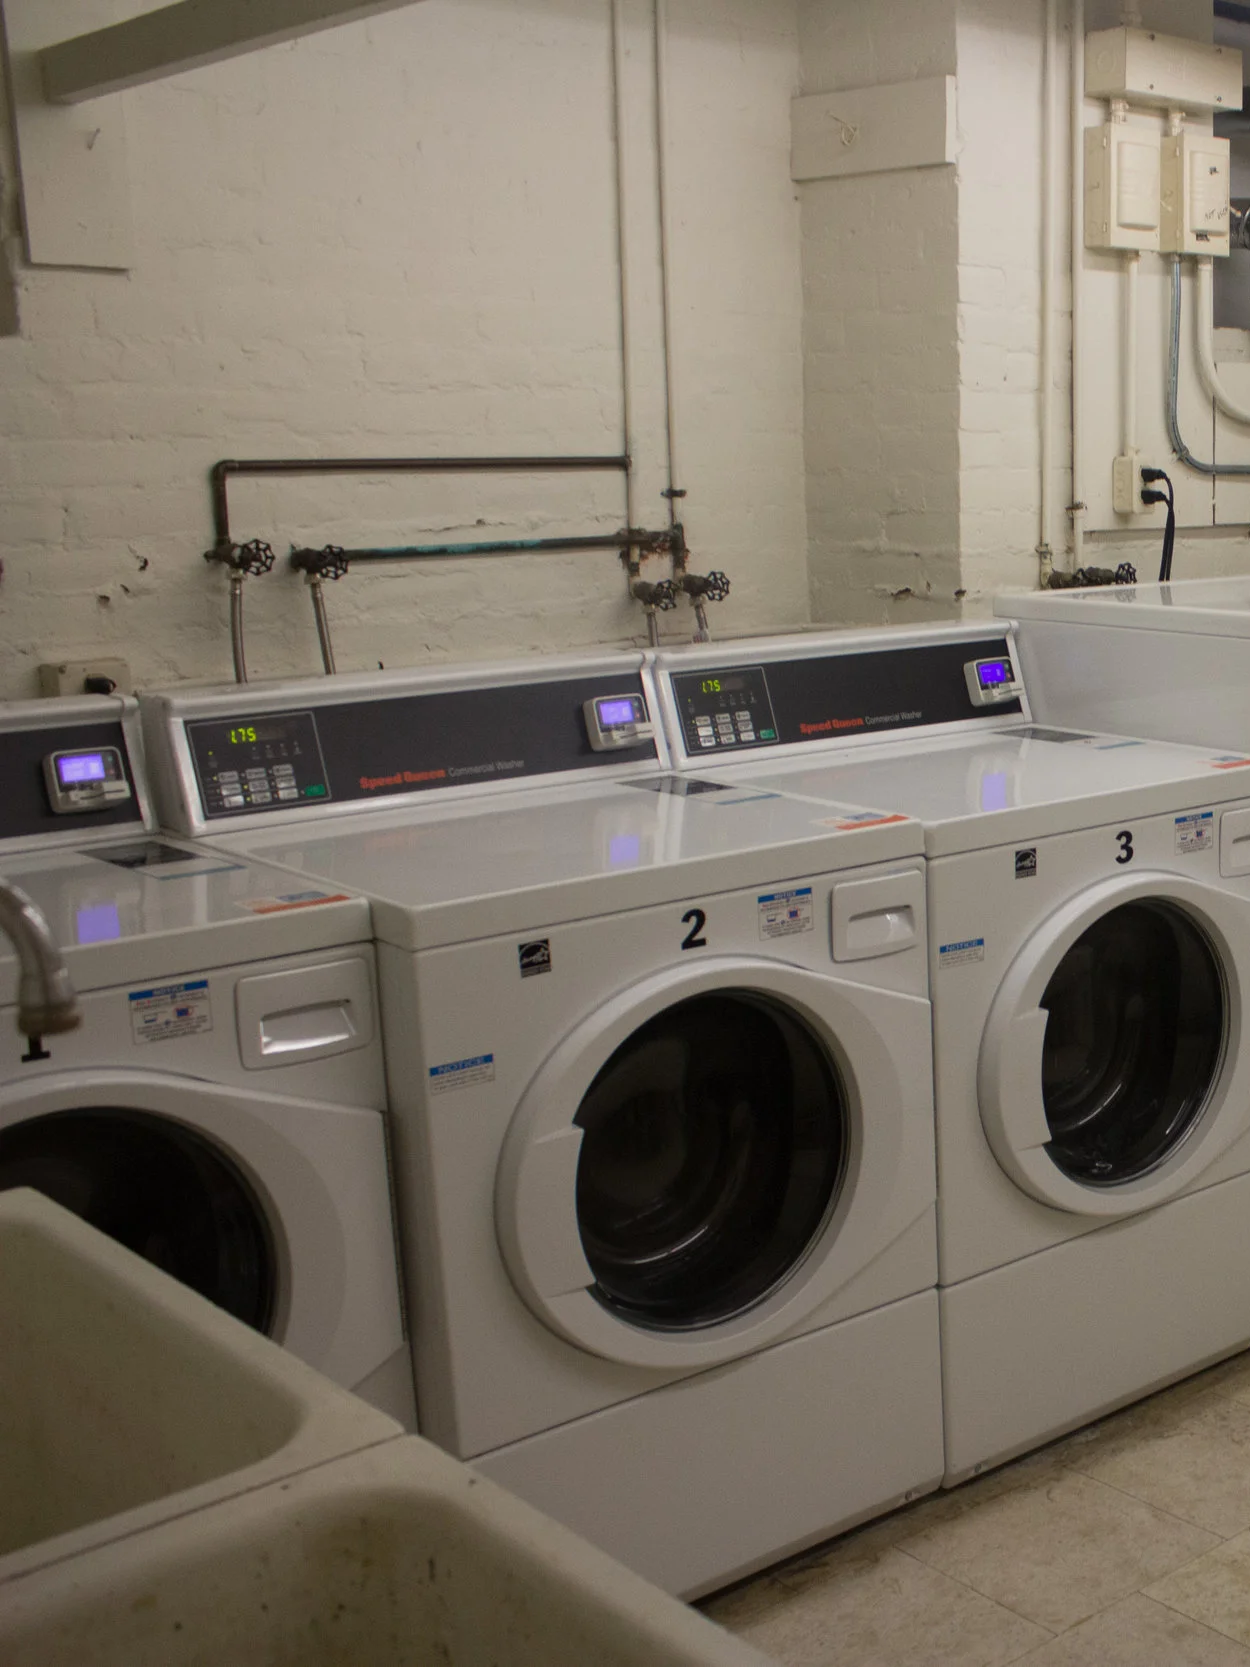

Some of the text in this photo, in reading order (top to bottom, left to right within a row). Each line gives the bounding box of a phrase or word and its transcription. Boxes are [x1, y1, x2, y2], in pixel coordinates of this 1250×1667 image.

[800, 721, 832, 735] Speed
[832, 717, 864, 729] Queen
[360, 772, 403, 789] Speed
[403, 769, 446, 783] Queen
[448, 763, 495, 777] Commercial
[1115, 830, 1134, 864] 3
[681, 908, 707, 950] 2
